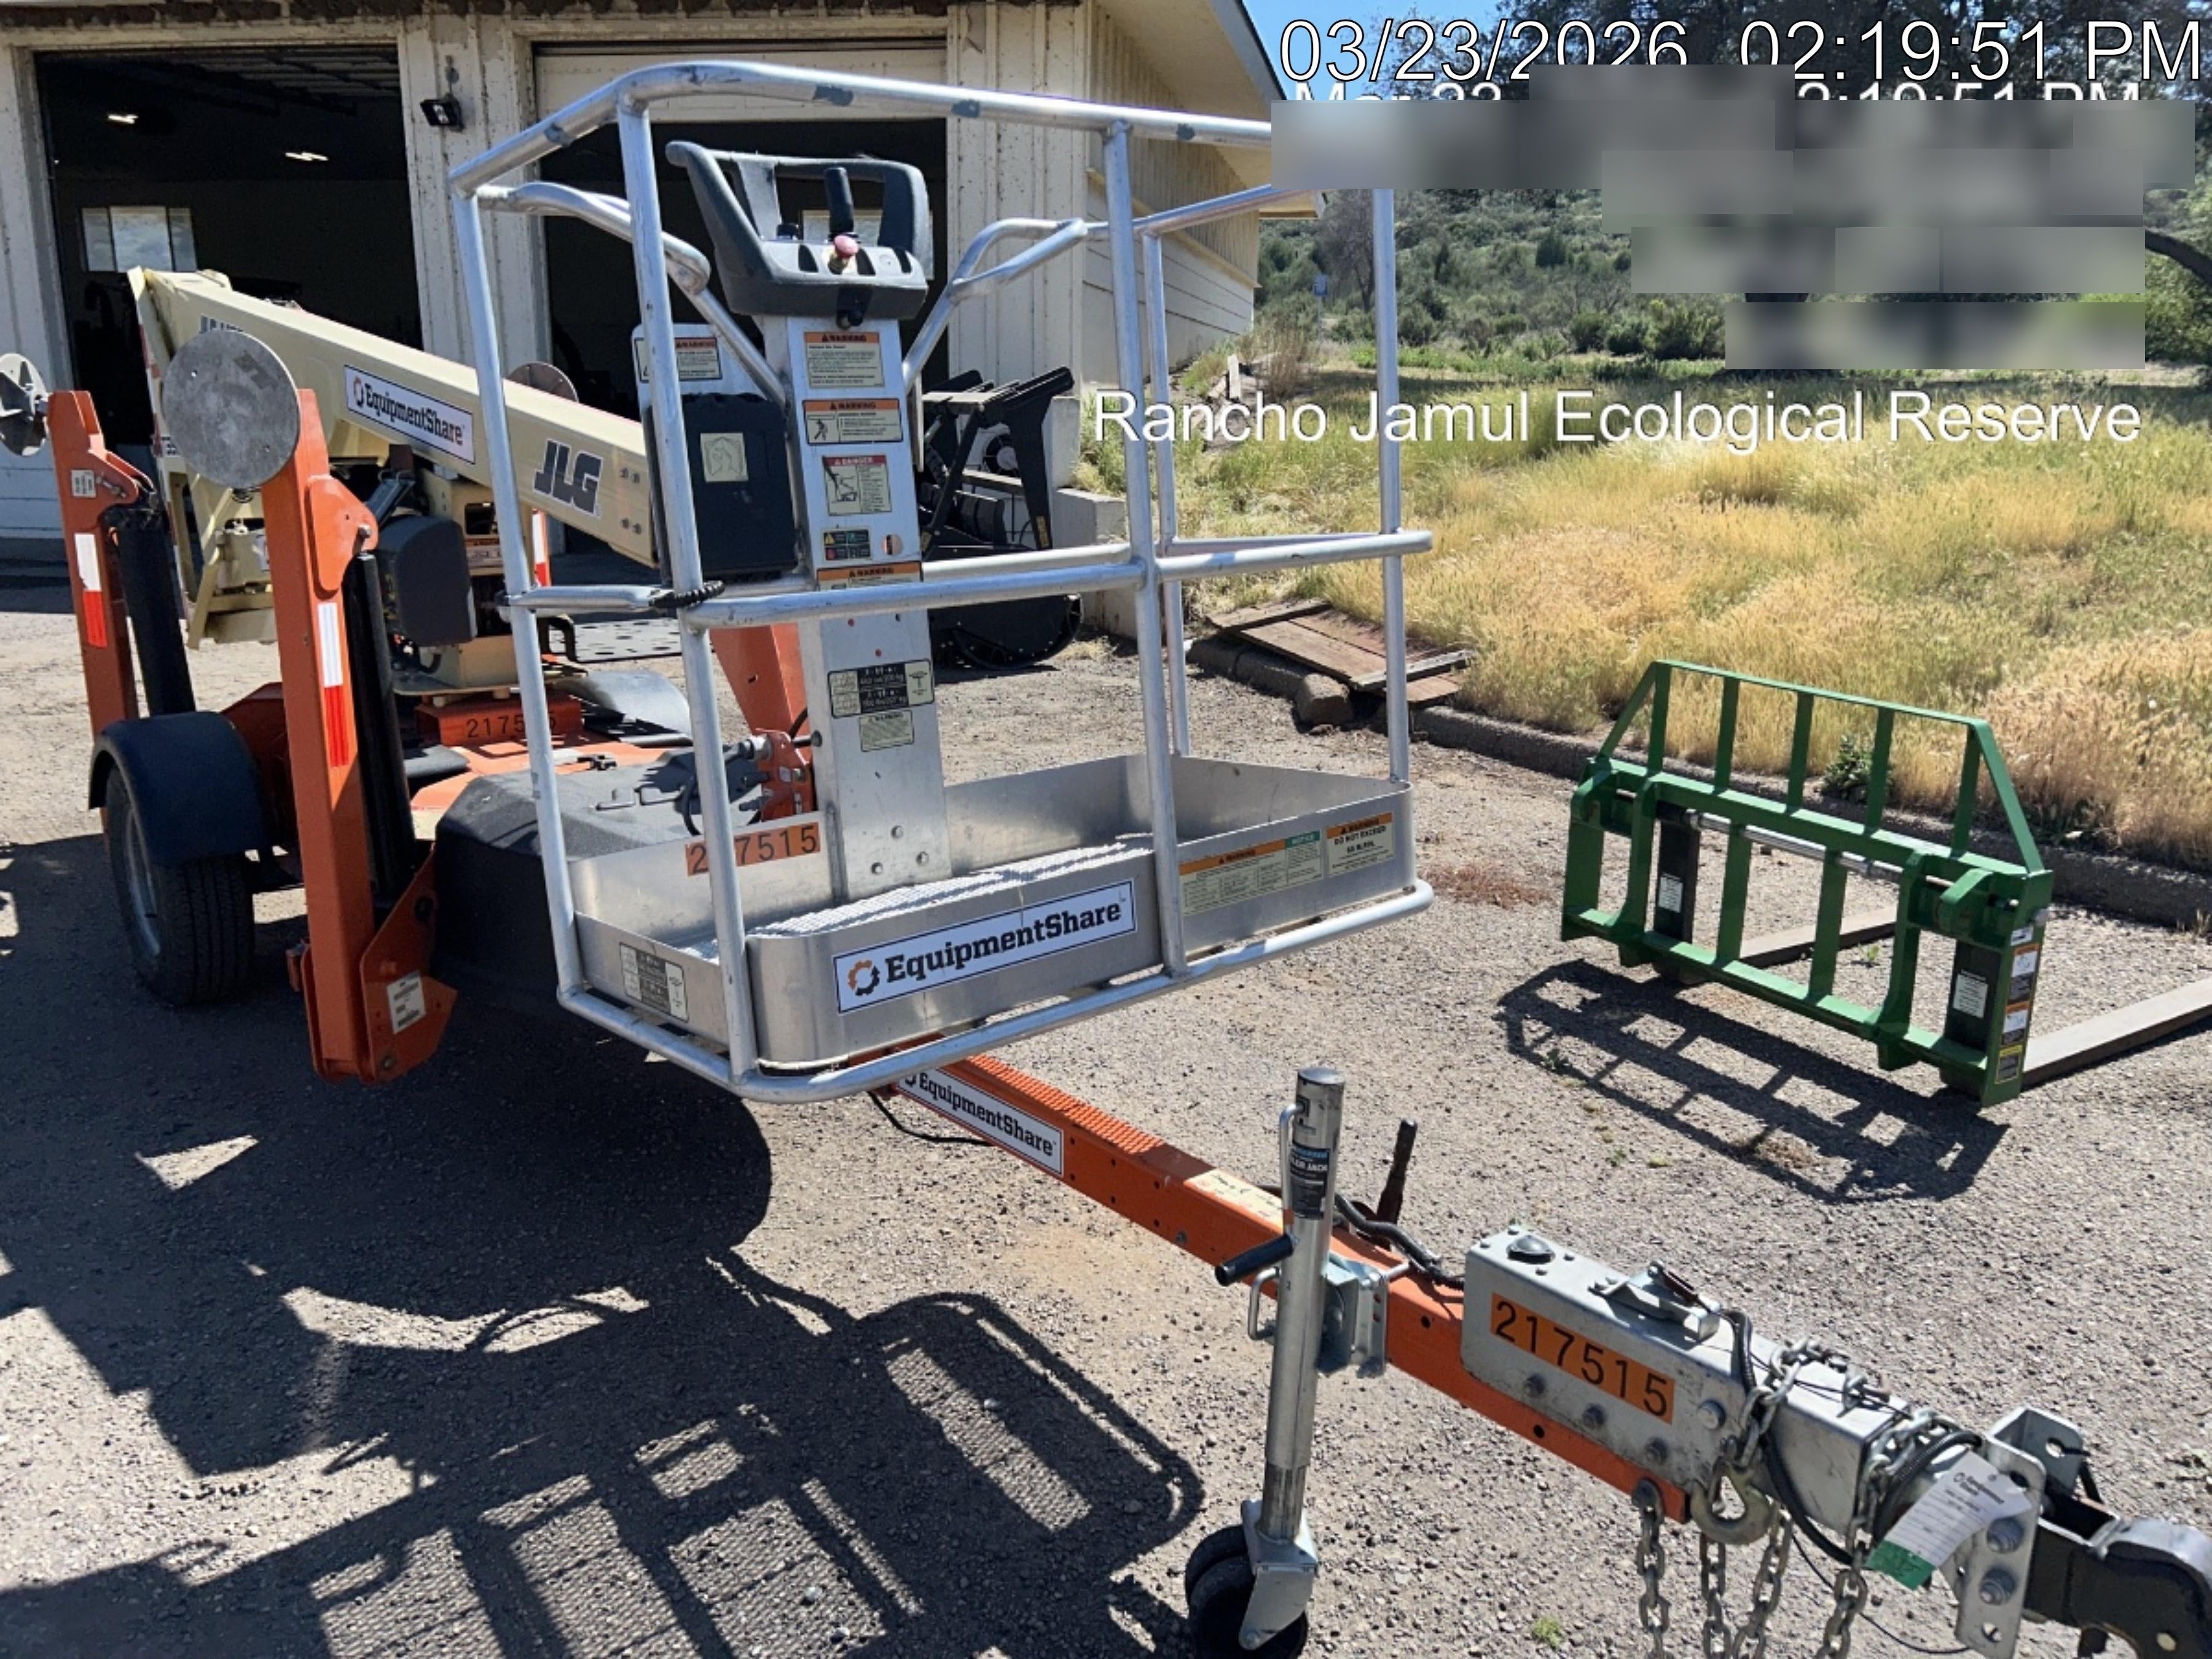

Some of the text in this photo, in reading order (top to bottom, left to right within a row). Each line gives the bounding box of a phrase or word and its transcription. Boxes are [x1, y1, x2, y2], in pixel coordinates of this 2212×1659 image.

[364, 382, 463, 447] EquipmentShare
[838, 401, 876, 410] WARNING
[532, 438, 603, 516] JLG
[690, 825, 817, 875] 27515
[885, 901, 1121, 983] EquipmentShare
[918, 1072, 1054, 1156] EquipmentShare
[1496, 1301, 1668, 1416] 217515
